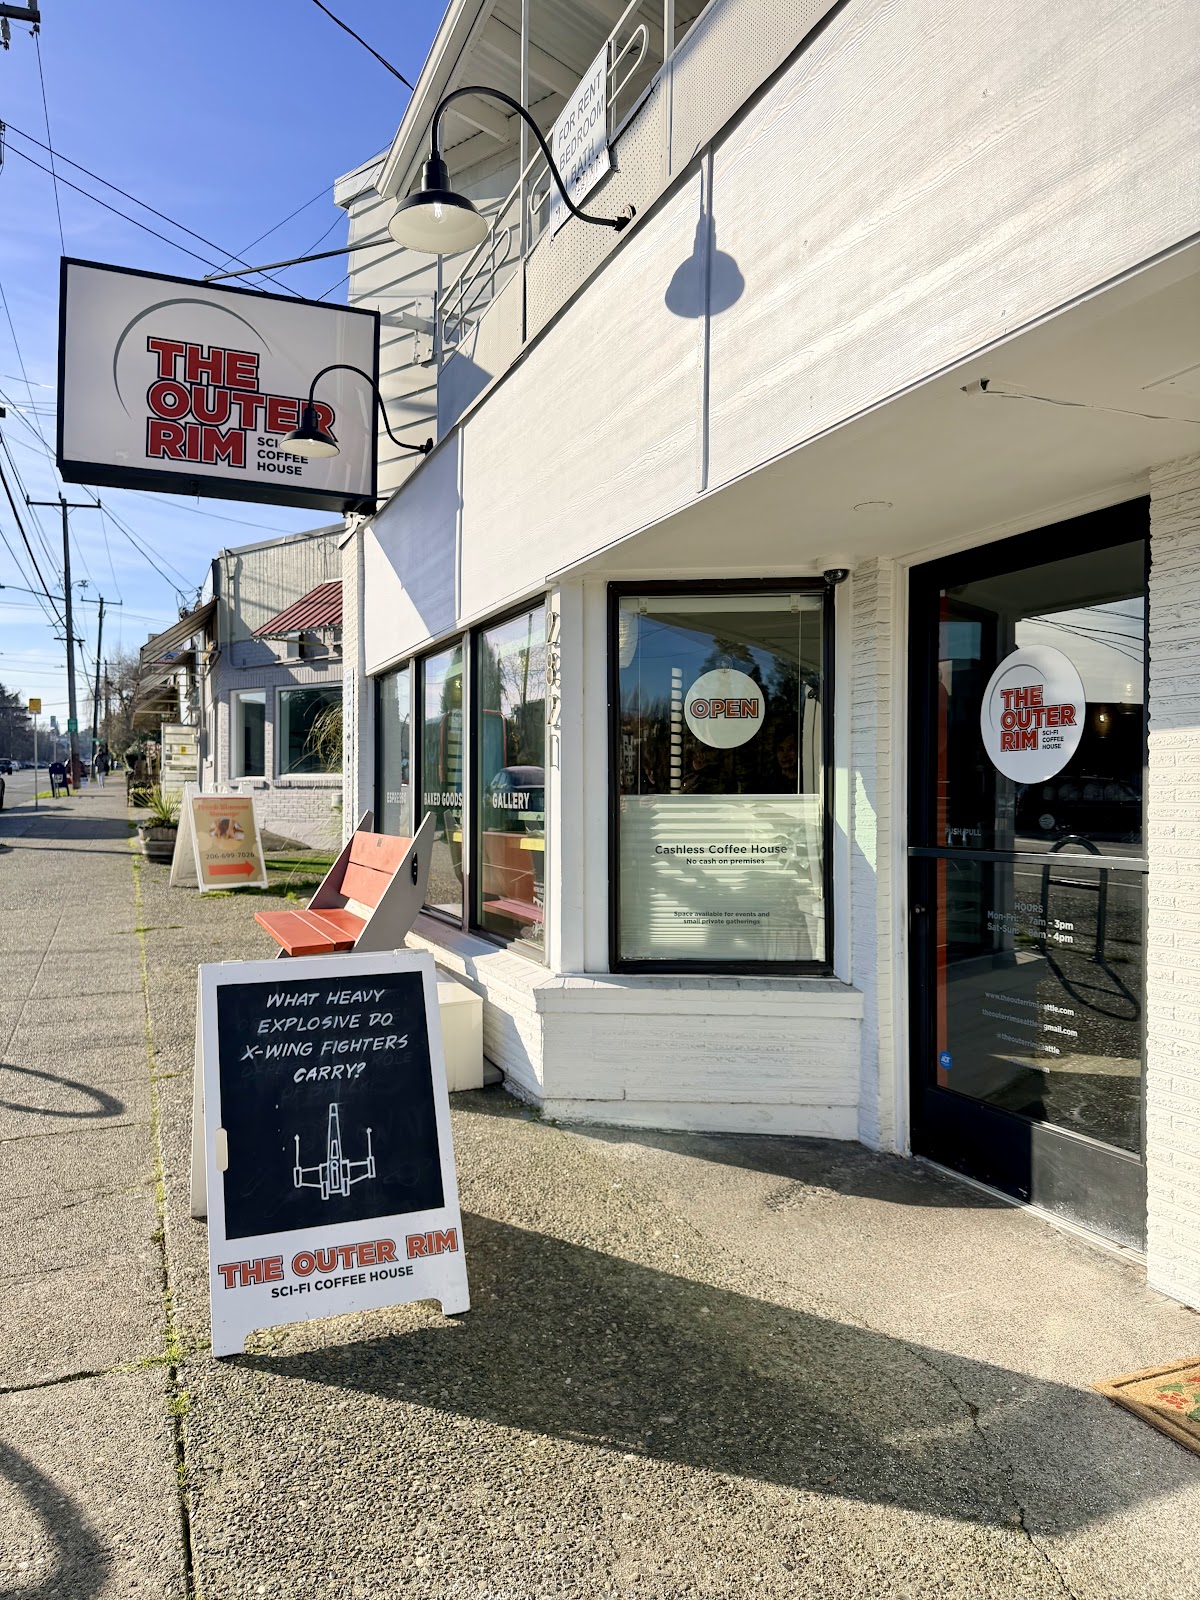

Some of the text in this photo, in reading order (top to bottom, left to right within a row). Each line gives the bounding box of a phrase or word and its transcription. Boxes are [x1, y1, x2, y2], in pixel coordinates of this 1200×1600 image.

[557, 68, 602, 149] FOR RENT
[559, 94, 604, 171] BEDROOM
[571, 138, 595, 185] BATH
[147, 335, 260, 393] THE
[146, 379, 339, 442] OUTER
[146, 417, 247, 469] RIM
[257, 436, 279, 448] SCI
[257, 449, 309, 465] COFFEE
[257, 461, 303, 476] HOUSE
[1000, 684, 1043, 710] THE
[690, 698, 759, 719] OPEN
[1001, 703, 1077, 731] OUTER
[1000, 728, 1039, 752] RIM
[424, 792, 463, 807] BAKED GOODS
[492, 792, 531, 809] GALLERY
[655, 844, 788, 855] Cashless Coffee House
[699, 857, 717, 865] cash
[730, 857, 765, 866] premises
[1014, 902, 1044, 913] HOURS
[725, 918, 761, 926] gatherings
[1029, 916, 1046, 926] 7am
[1054, 919, 1074, 931] 3pm
[1053, 932, 1074, 944] 4pm
[266, 989, 386, 1008] WHAT HEAVY
[257, 1012, 394, 1034] EXPLOSIVE DO
[240, 1034, 409, 1061] X-WING FIGHTERS
[293, 1062, 367, 1083] CARRY?
[218, 1228, 459, 1289] THE OUTER RIM
[270, 1265, 414, 1298] SCI-FI COFFEE HOUSE
